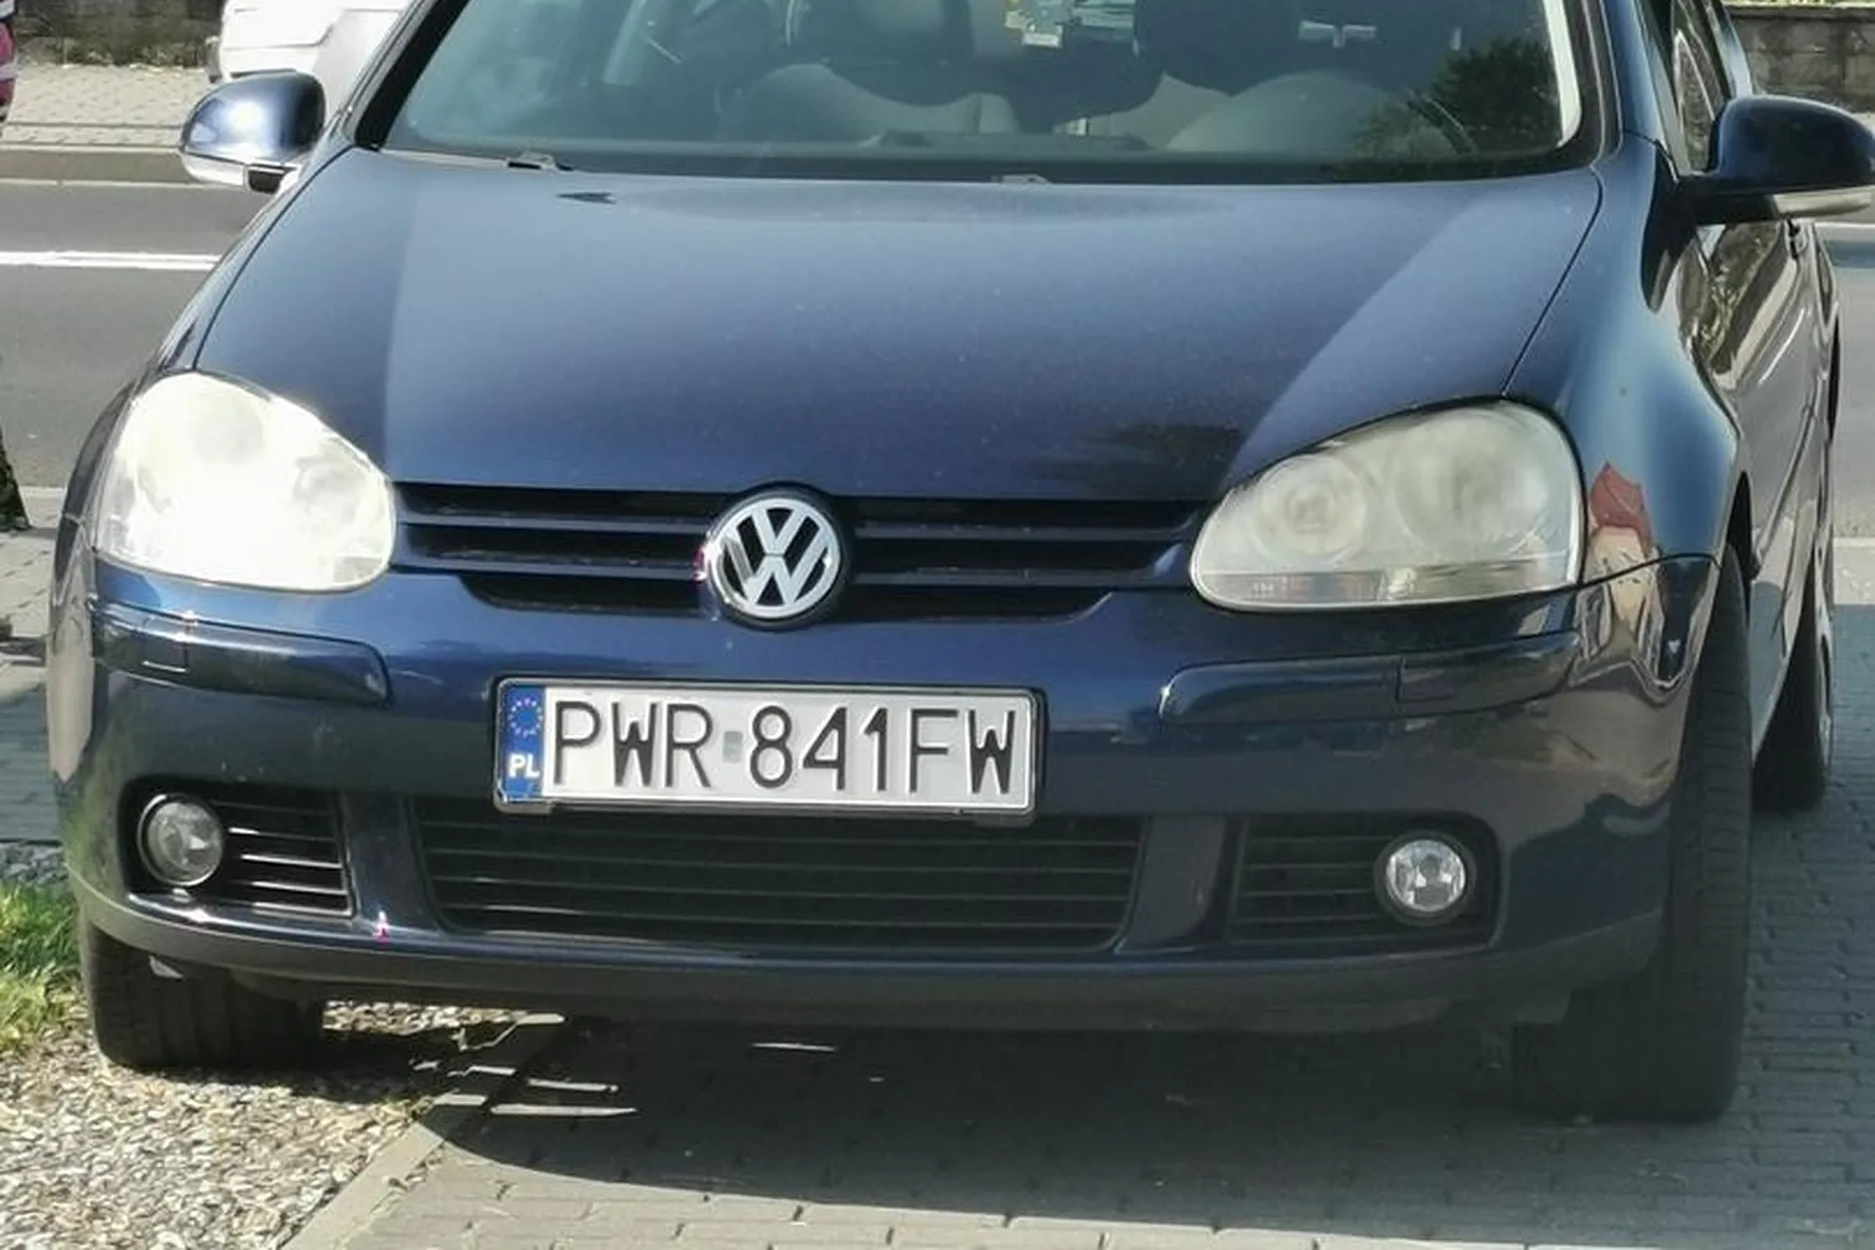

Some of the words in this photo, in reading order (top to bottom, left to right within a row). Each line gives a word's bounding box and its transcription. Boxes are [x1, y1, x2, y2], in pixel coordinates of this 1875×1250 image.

[714, 502, 838, 614] VW
[509, 752, 541, 778] PL
[553, 700, 713, 787] PWR
[749, 706, 1015, 794] 841FW
